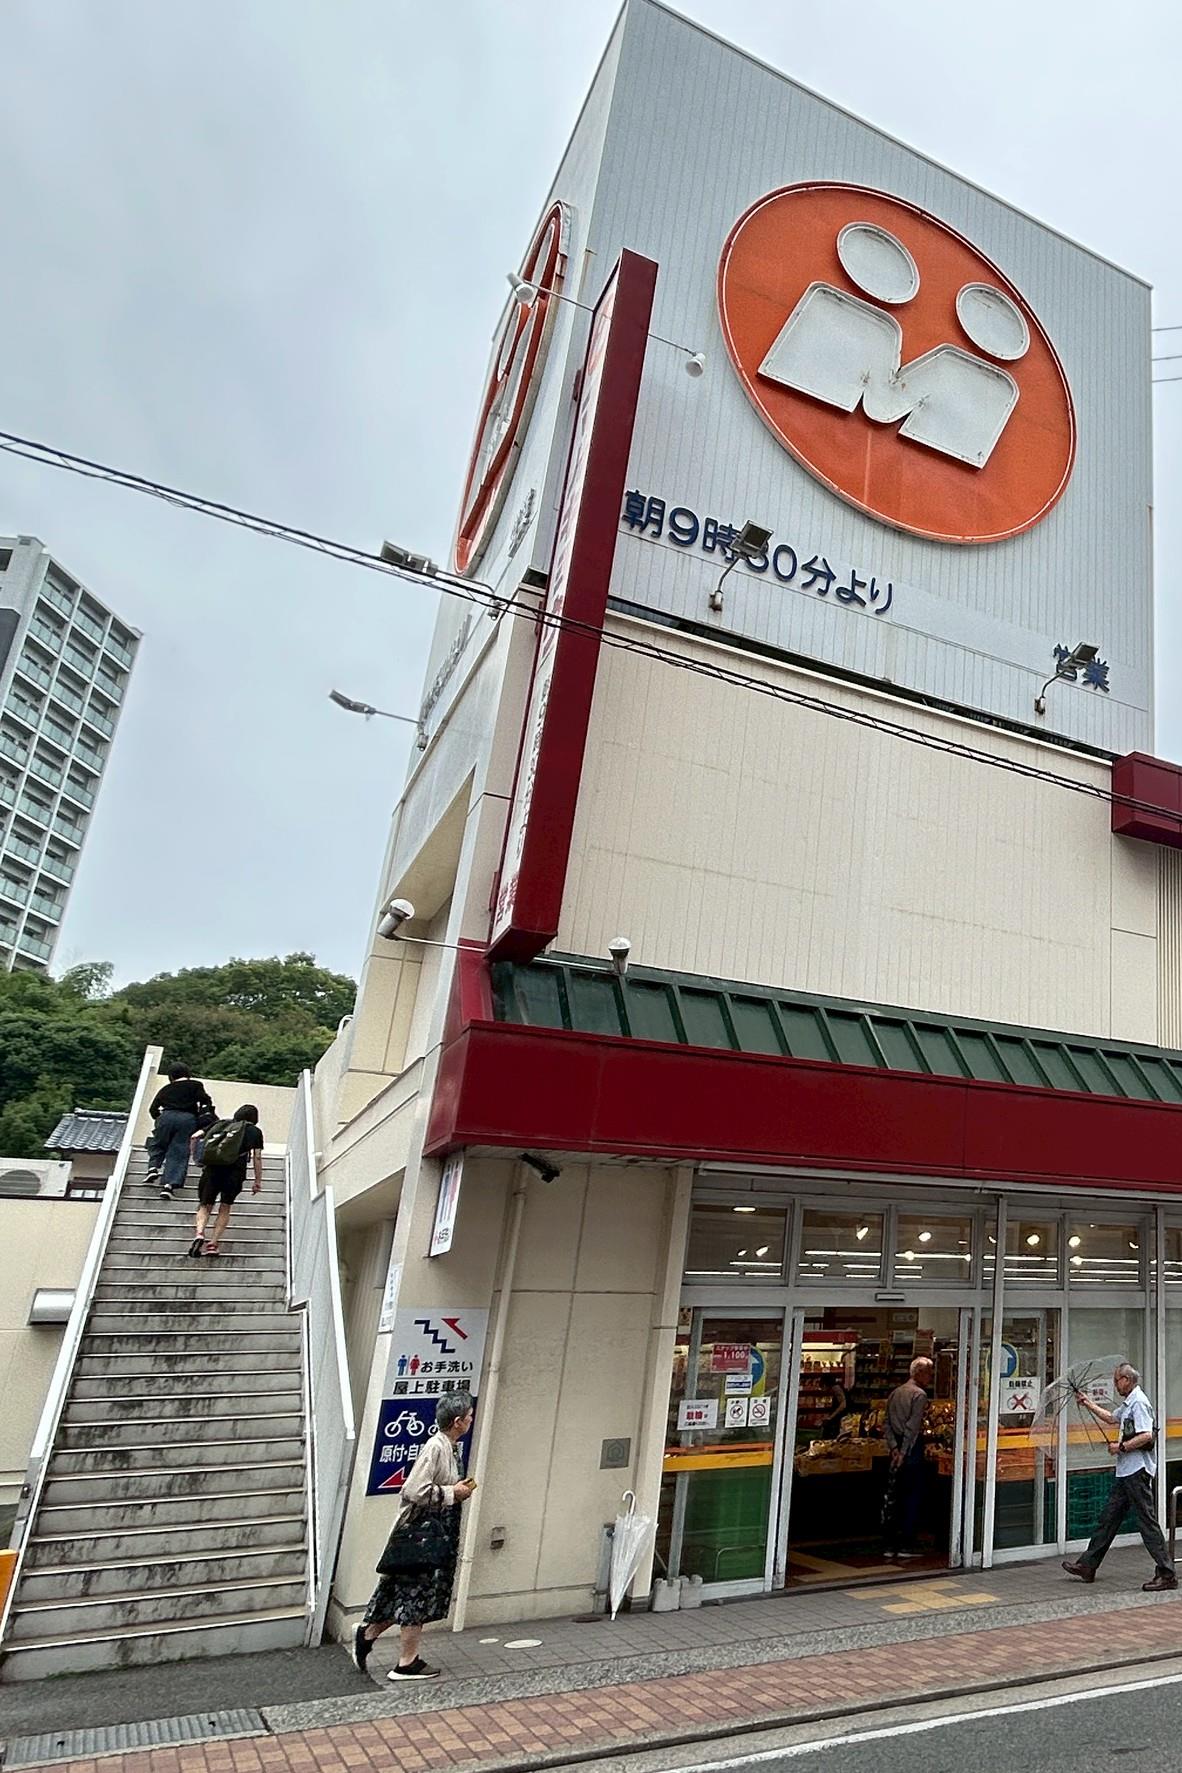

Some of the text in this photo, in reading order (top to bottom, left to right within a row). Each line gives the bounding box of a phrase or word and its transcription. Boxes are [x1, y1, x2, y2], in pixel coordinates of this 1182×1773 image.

[420, 1361, 474, 1374] お手洗い
[393, 1379, 471, 1395] 屋上駐車場
